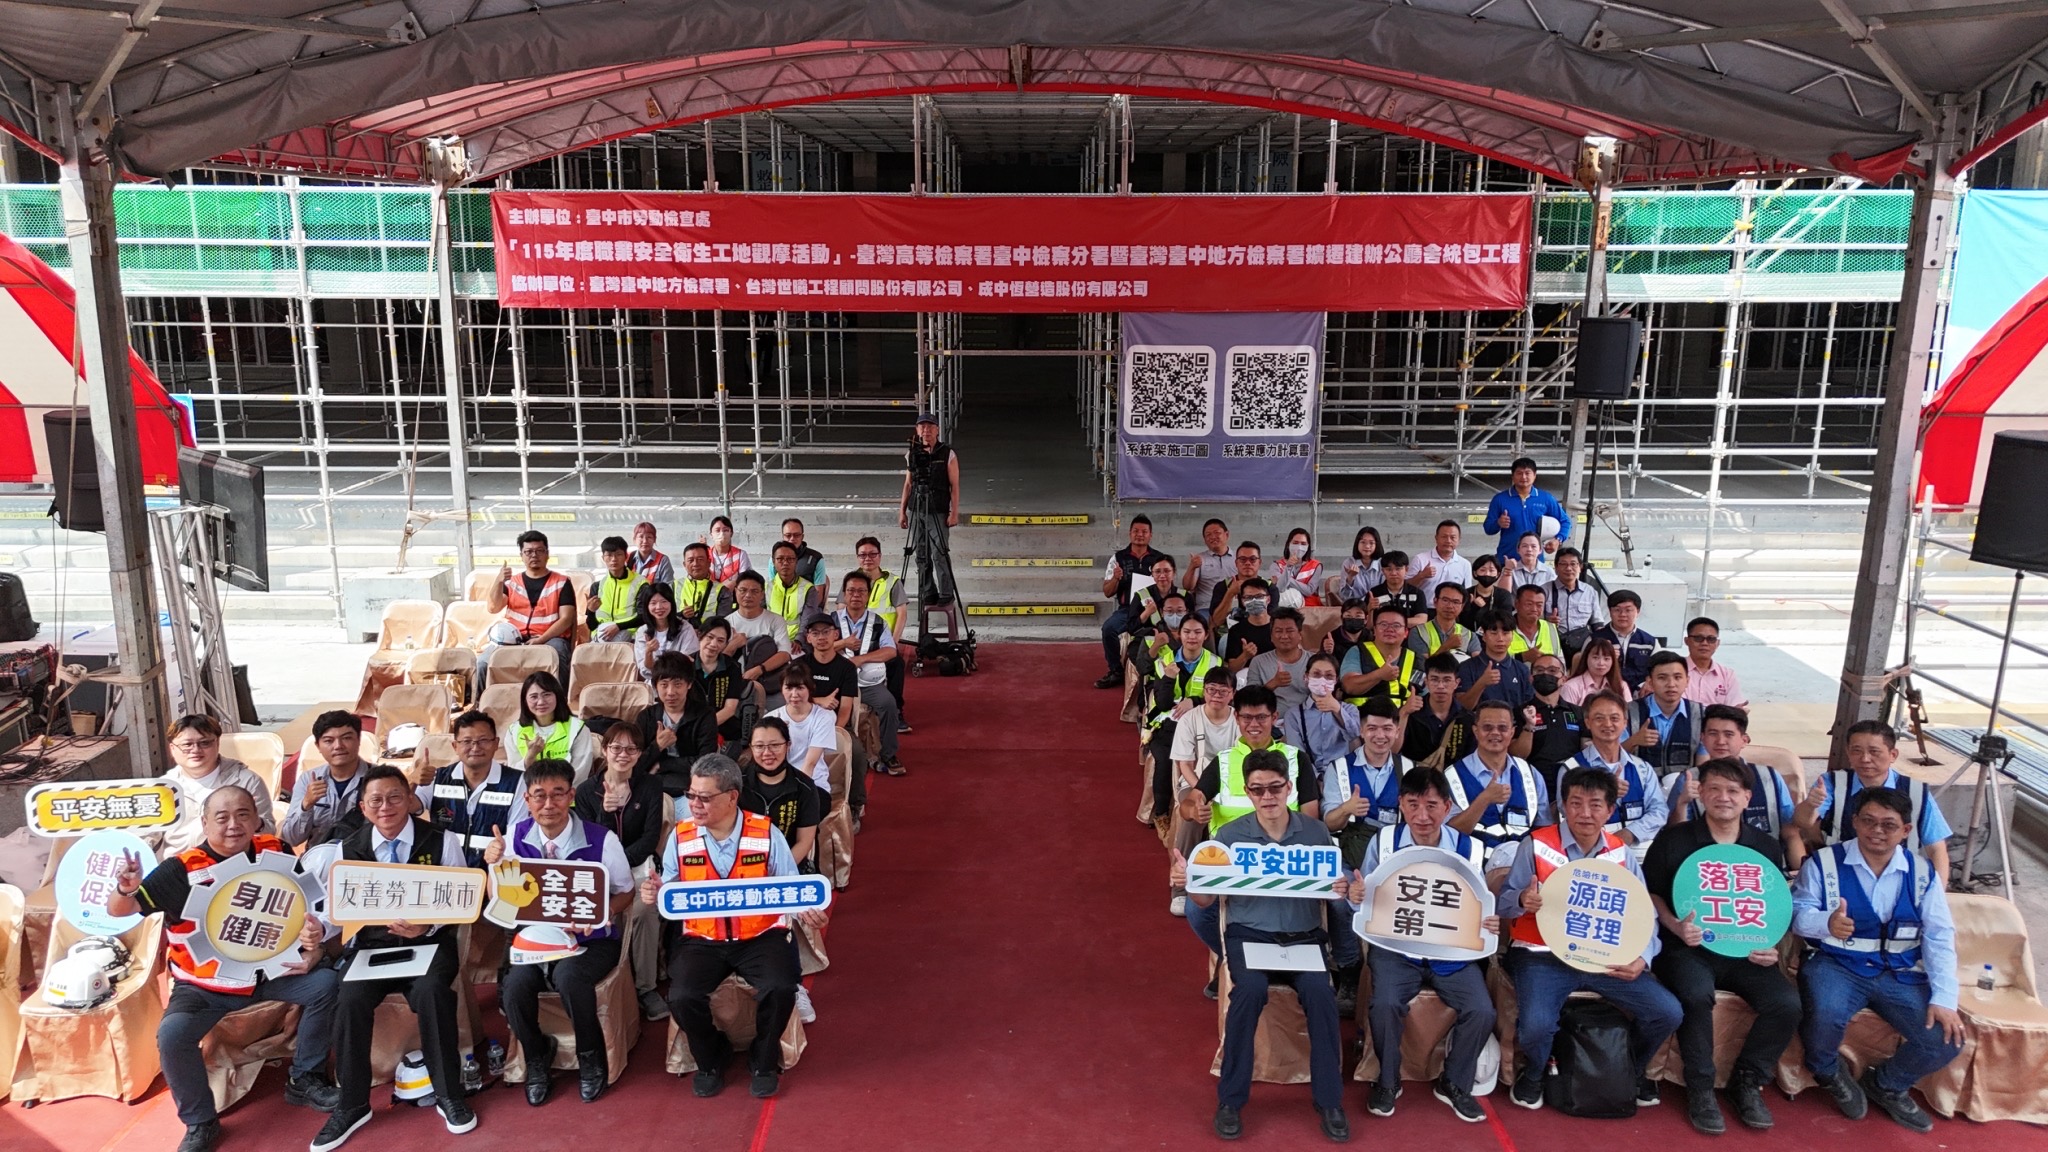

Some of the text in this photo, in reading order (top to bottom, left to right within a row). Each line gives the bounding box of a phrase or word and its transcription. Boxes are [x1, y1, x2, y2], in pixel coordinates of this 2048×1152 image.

[1126, 442, 1209, 458] 系統架施工圖
[1222, 442, 1310, 458] 系統架應力計算書
[51, 793, 162, 823] 平安無憂
[1234, 846, 1338, 877] 平安出門
[541, 869, 596, 894] 全員
[1397, 874, 1463, 910] 安全
[1697, 860, 1763, 895] 落實
[80, 880, 115, 906] 促
[231, 880, 297, 918] 身心
[337, 880, 477, 910] 友善勞工城市
[541, 895, 598, 920] 安全
[671, 885, 818, 911] 臺中市勞動檢查處
[1567, 879, 1629, 918] 源頭
[1393, 907, 1459, 937] 第一
[1700, 895, 1768, 929] 工安
[218, 914, 285, 951] 健康
[1564, 910, 1622, 947] 管理
